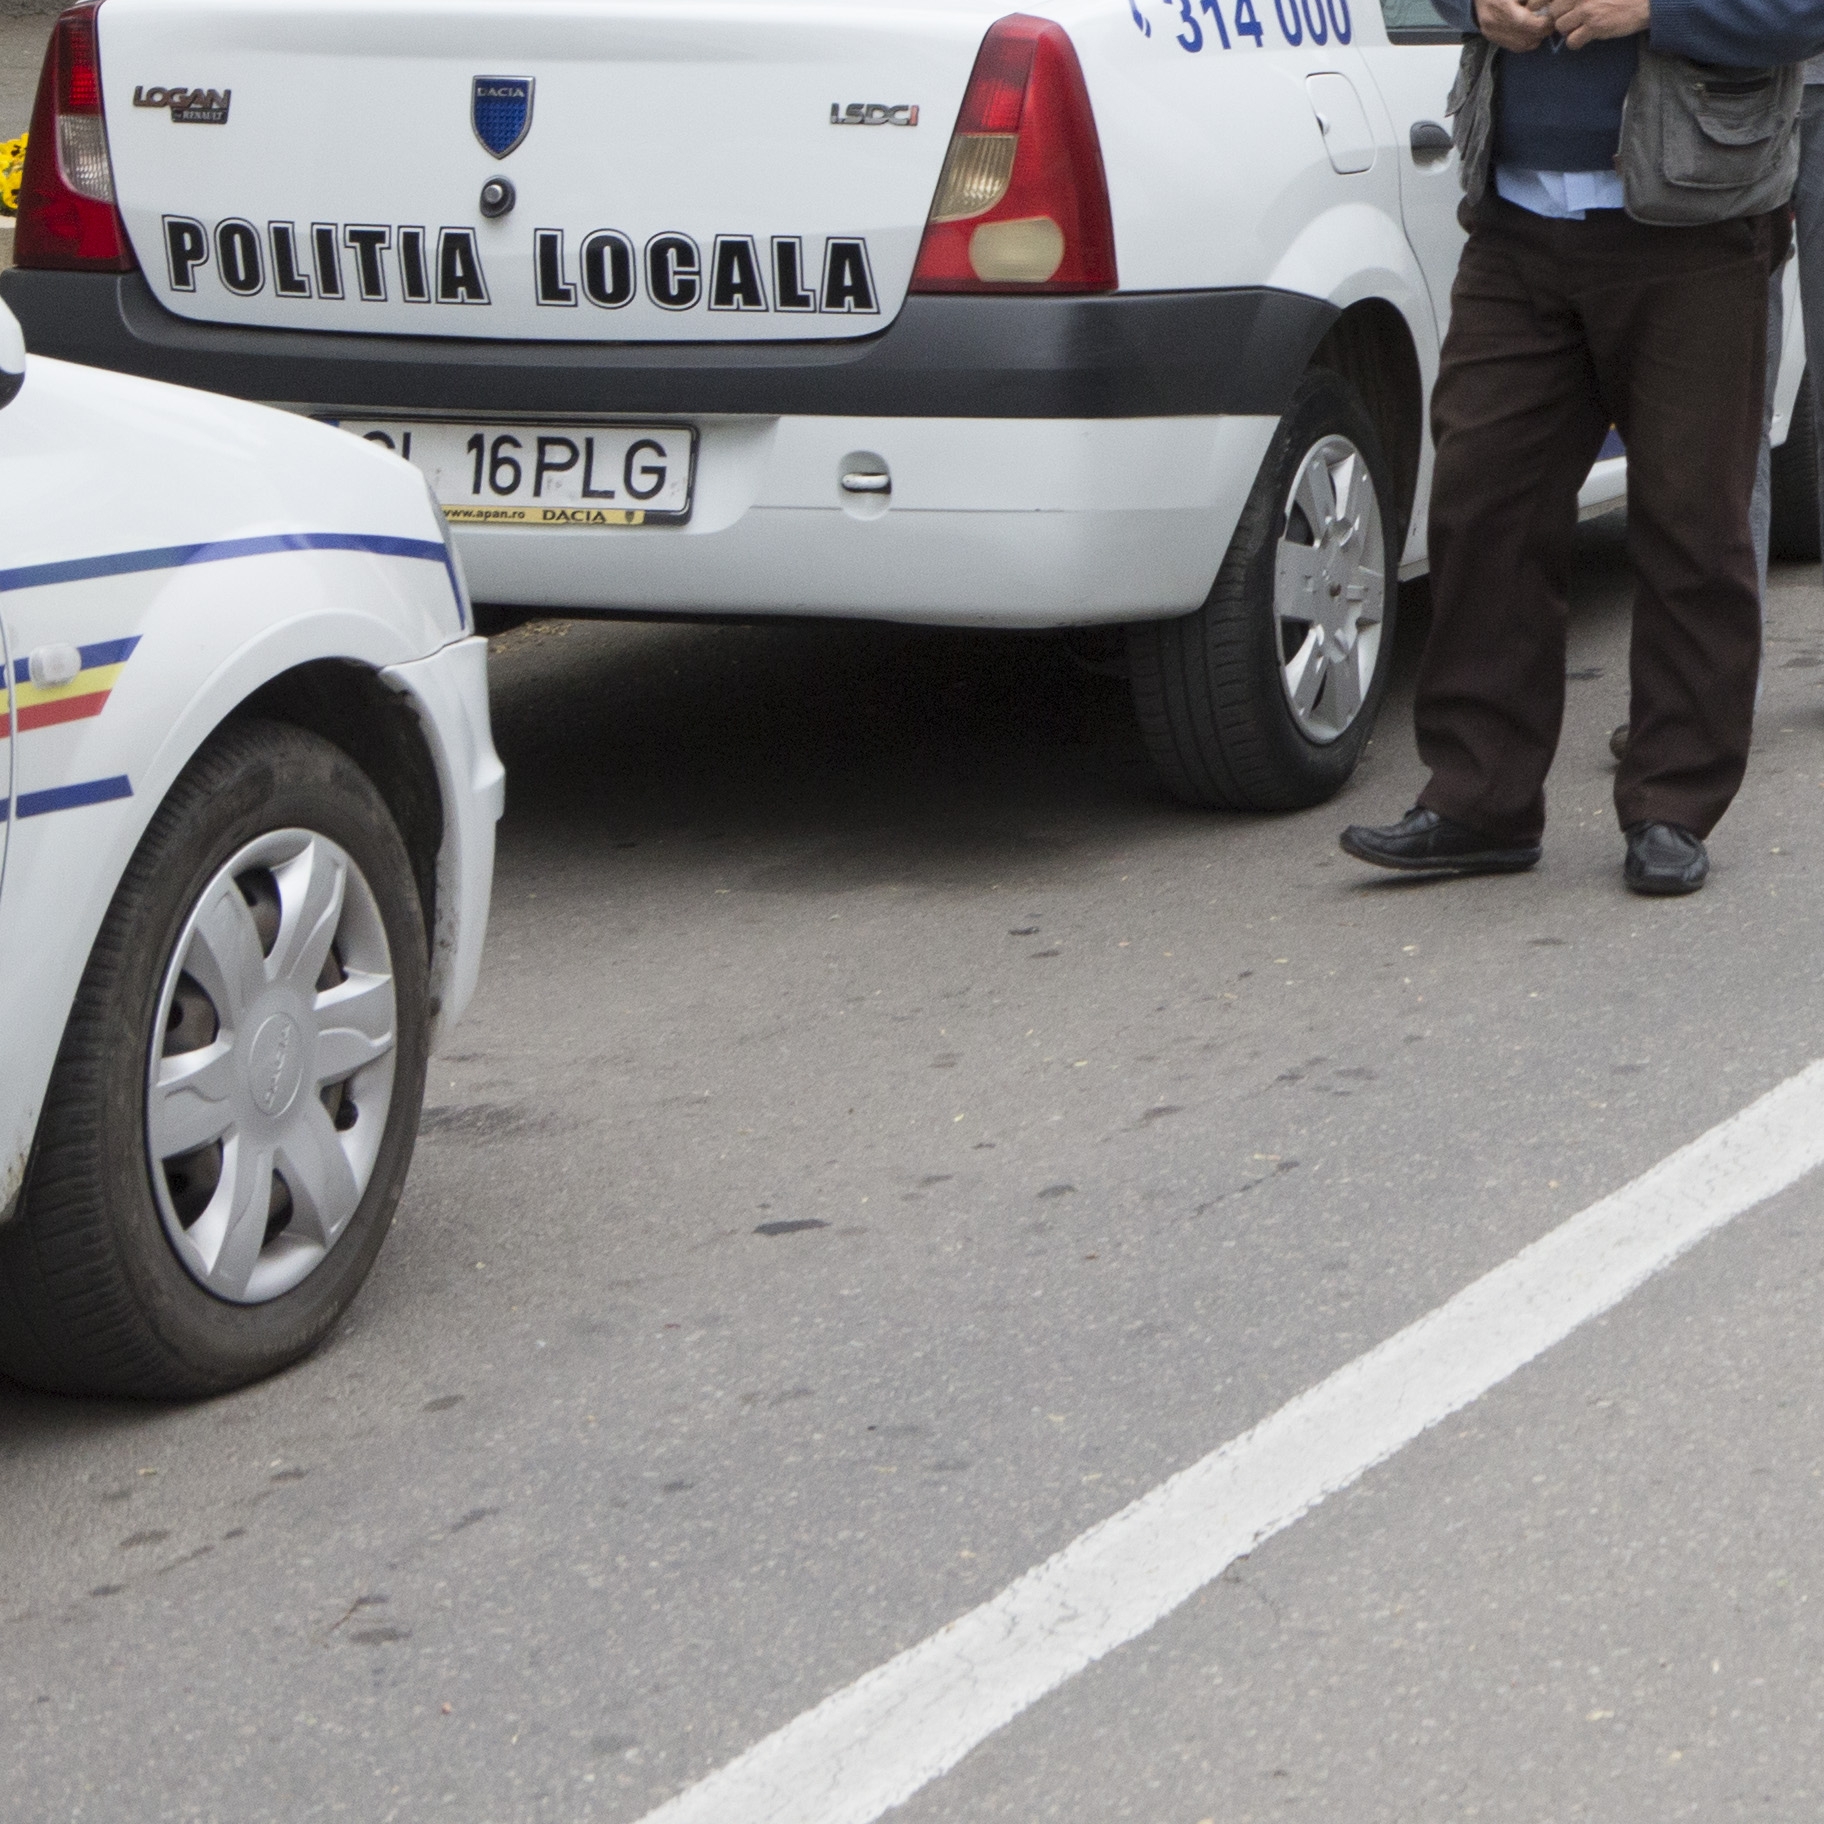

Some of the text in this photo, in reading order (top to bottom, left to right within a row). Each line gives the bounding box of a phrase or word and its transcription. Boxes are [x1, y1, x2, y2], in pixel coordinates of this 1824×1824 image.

[133, 85, 232, 108] LOGAN
[477, 87, 525, 97] DACIA
[182, 110, 223, 121] RENAULT
[162, 215, 881, 315] POLITIA LOCALA
[543, 509, 607, 524] DACIA
